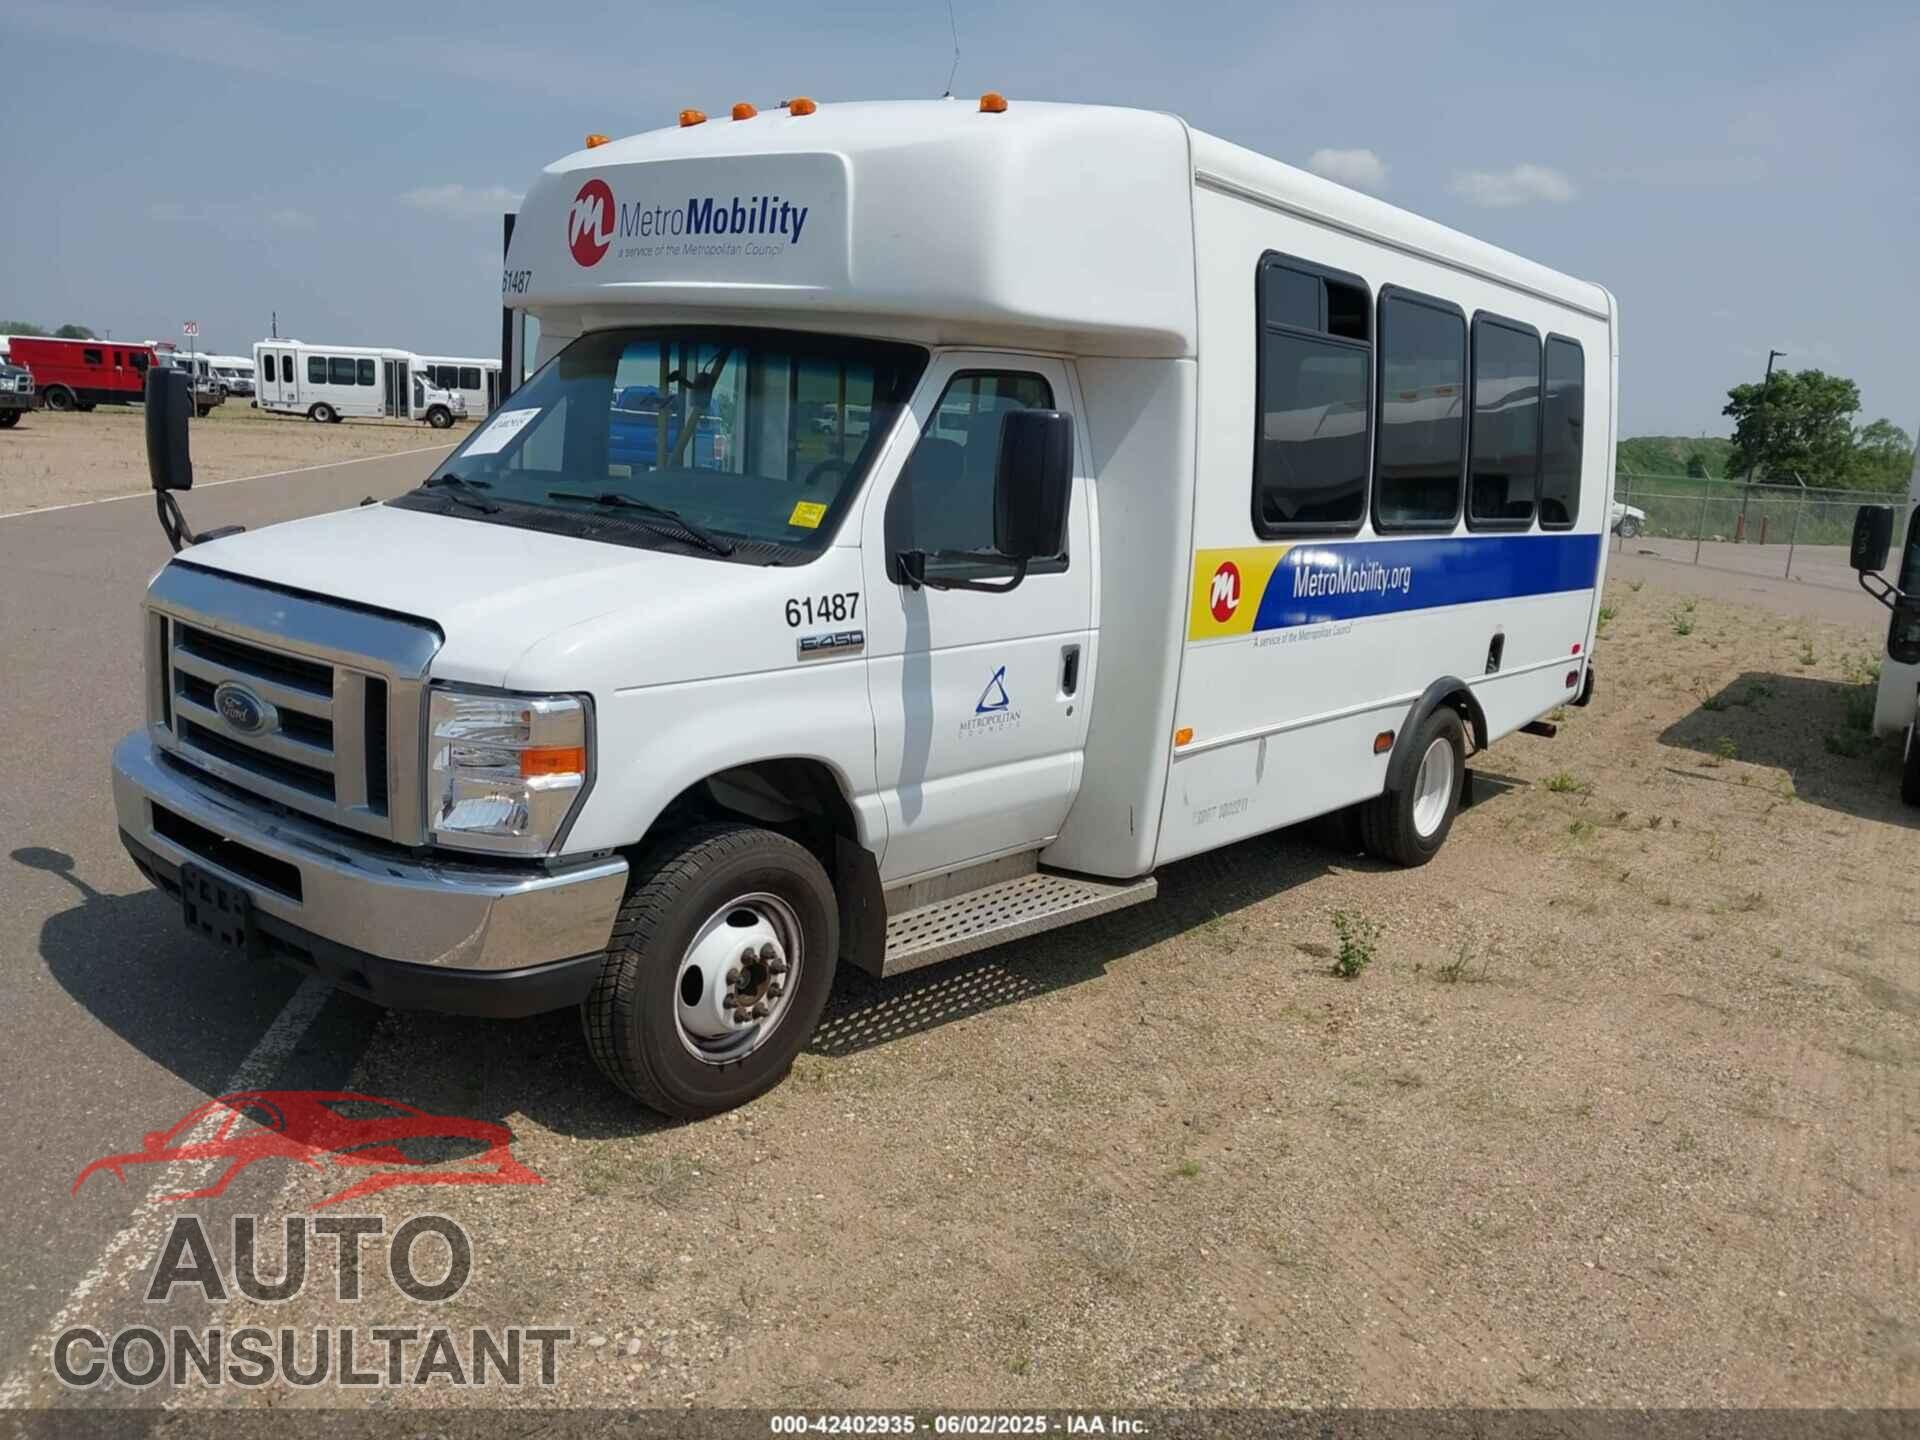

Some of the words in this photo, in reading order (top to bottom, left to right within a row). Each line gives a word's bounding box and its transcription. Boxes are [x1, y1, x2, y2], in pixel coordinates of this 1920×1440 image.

[618, 196, 808, 244] MetroMobility
[682, 241, 742, 257] Metropolitan
[745, 240, 784, 257] Council
[185, 322, 198, 334] 20
[1293, 562, 1411, 597] MetroMobility.org
[785, 592, 860, 628] 61487
[960, 711, 1021, 730] METROPOLITAN
